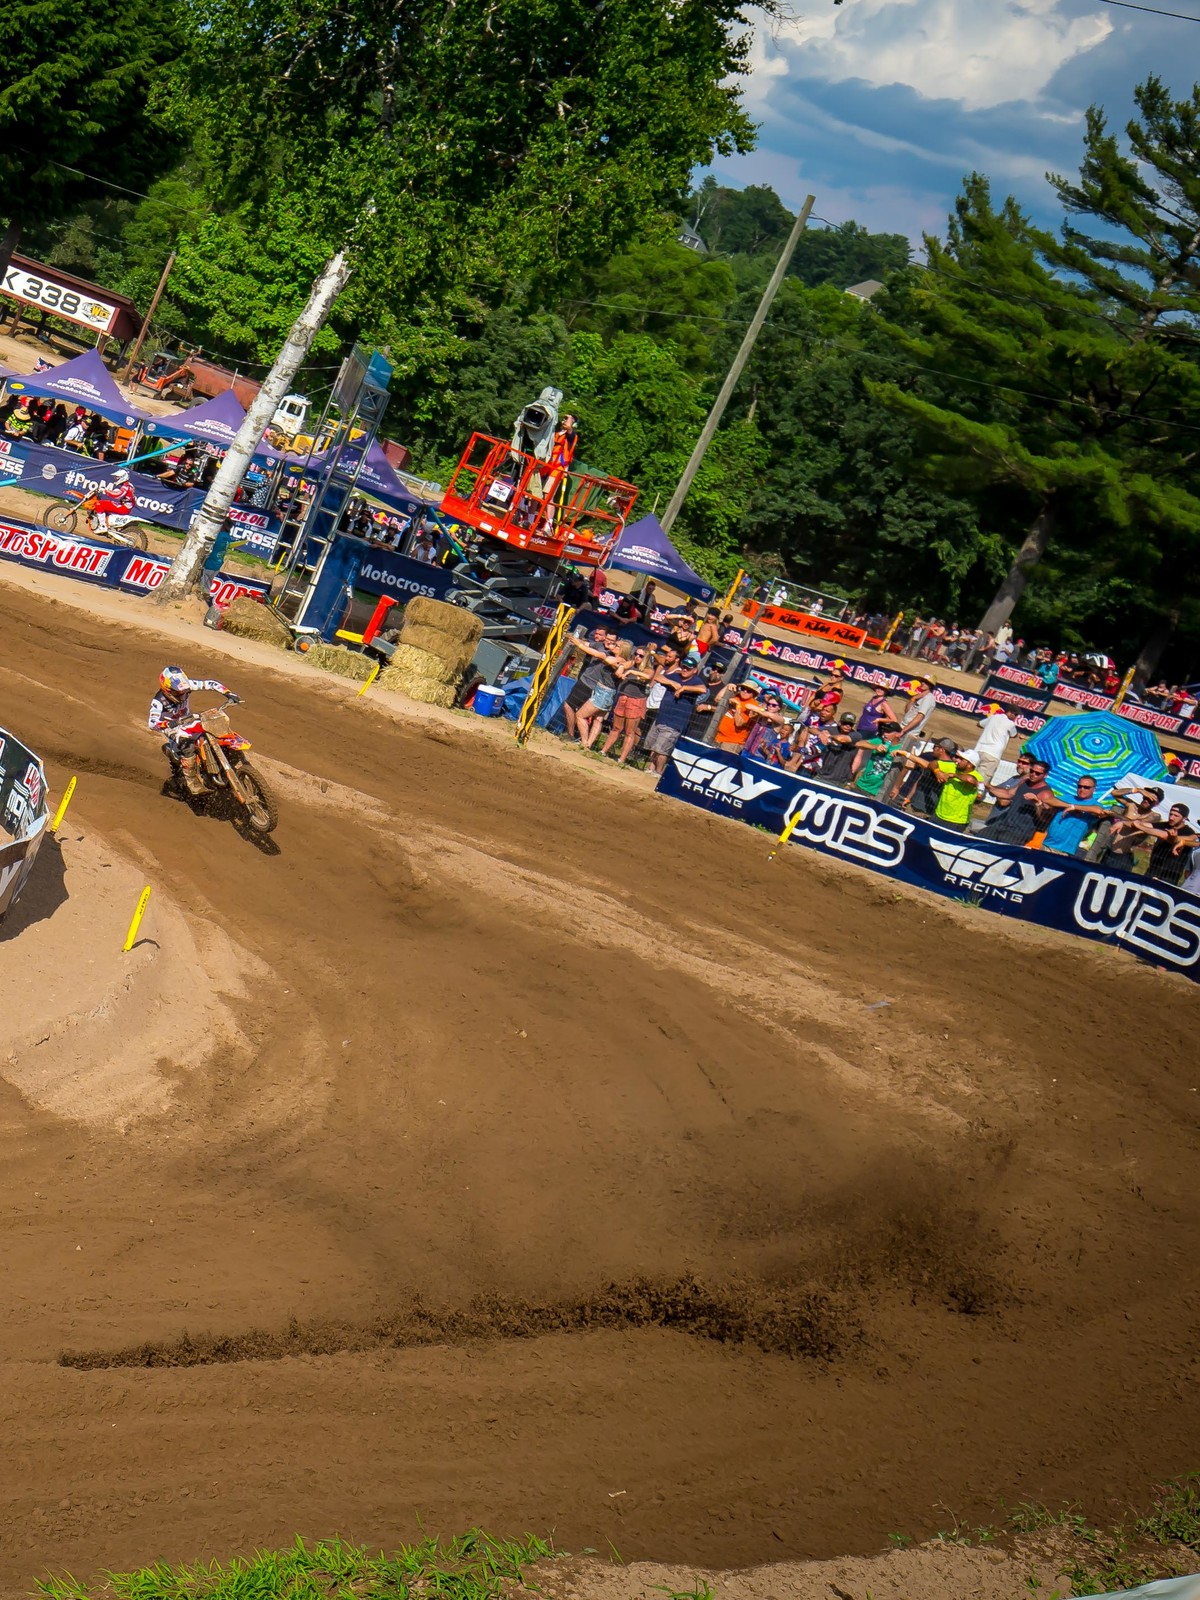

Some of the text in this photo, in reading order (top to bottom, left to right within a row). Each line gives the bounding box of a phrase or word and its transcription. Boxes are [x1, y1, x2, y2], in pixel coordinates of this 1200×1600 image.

[23, 278, 81, 314] 338
[249, 515, 266, 527] OIL
[360, 564, 436, 598] Motocross
[778, 613, 862, 644] KTM KTM KTM
[671, 748, 782, 801] FLY
[681, 779, 744, 809] RACING
[783, 788, 915, 868] WPS
[929, 836, 1065, 895] FLY
[944, 872, 1024, 904] RACING
[1074, 872, 1200, 967] WPS
